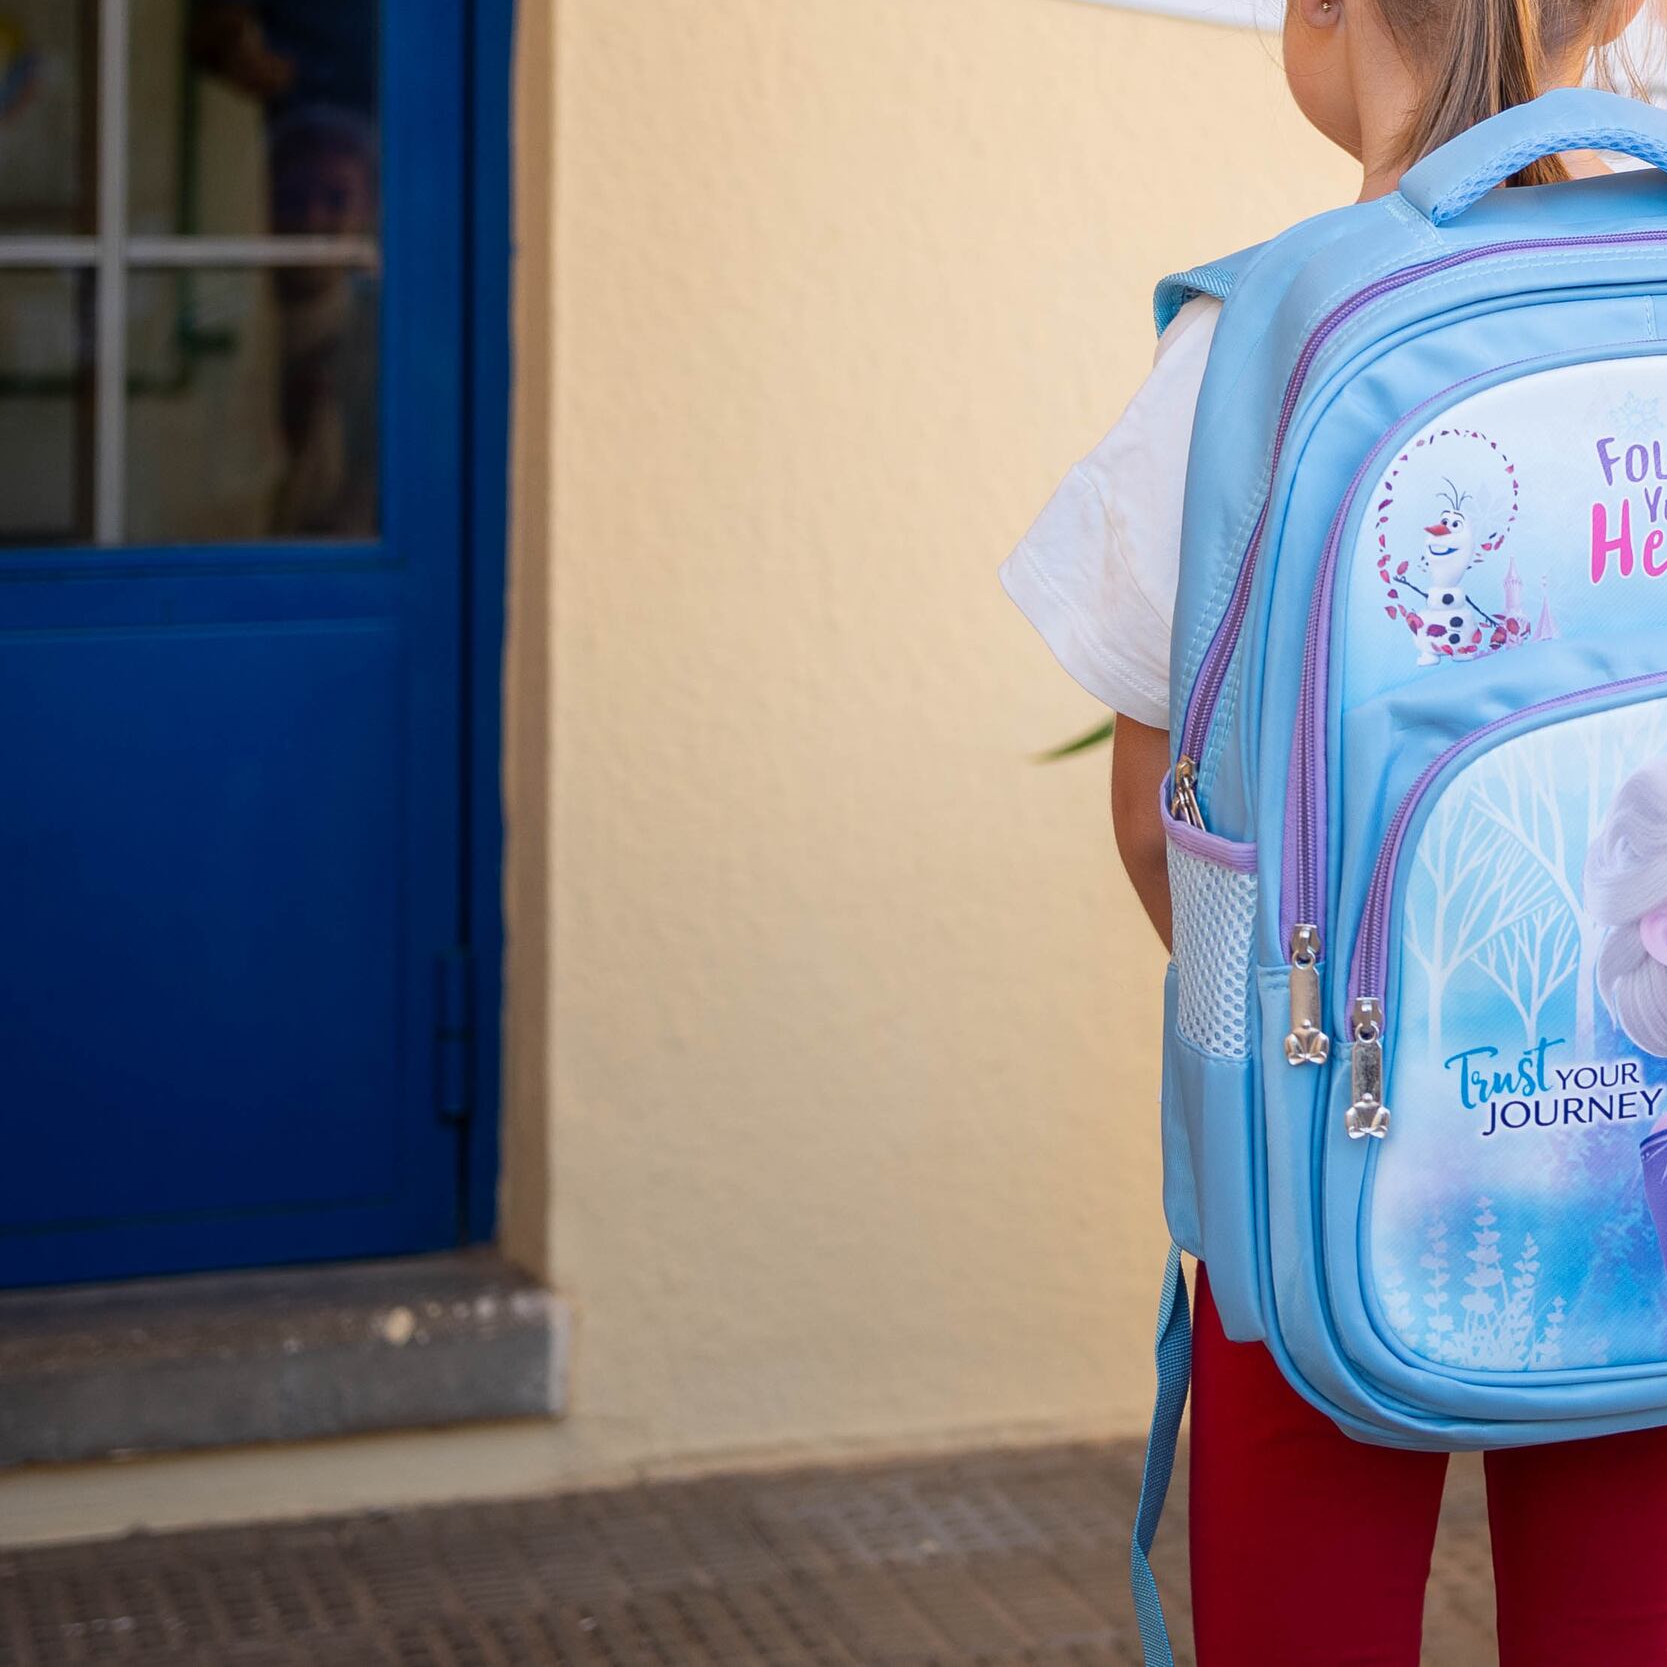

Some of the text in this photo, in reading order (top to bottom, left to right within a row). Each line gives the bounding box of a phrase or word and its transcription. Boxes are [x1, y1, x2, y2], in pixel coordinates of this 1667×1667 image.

[1444, 1037, 1640, 1110] Trust YOUR
[1482, 1088, 1663, 1136] JOURNEY
